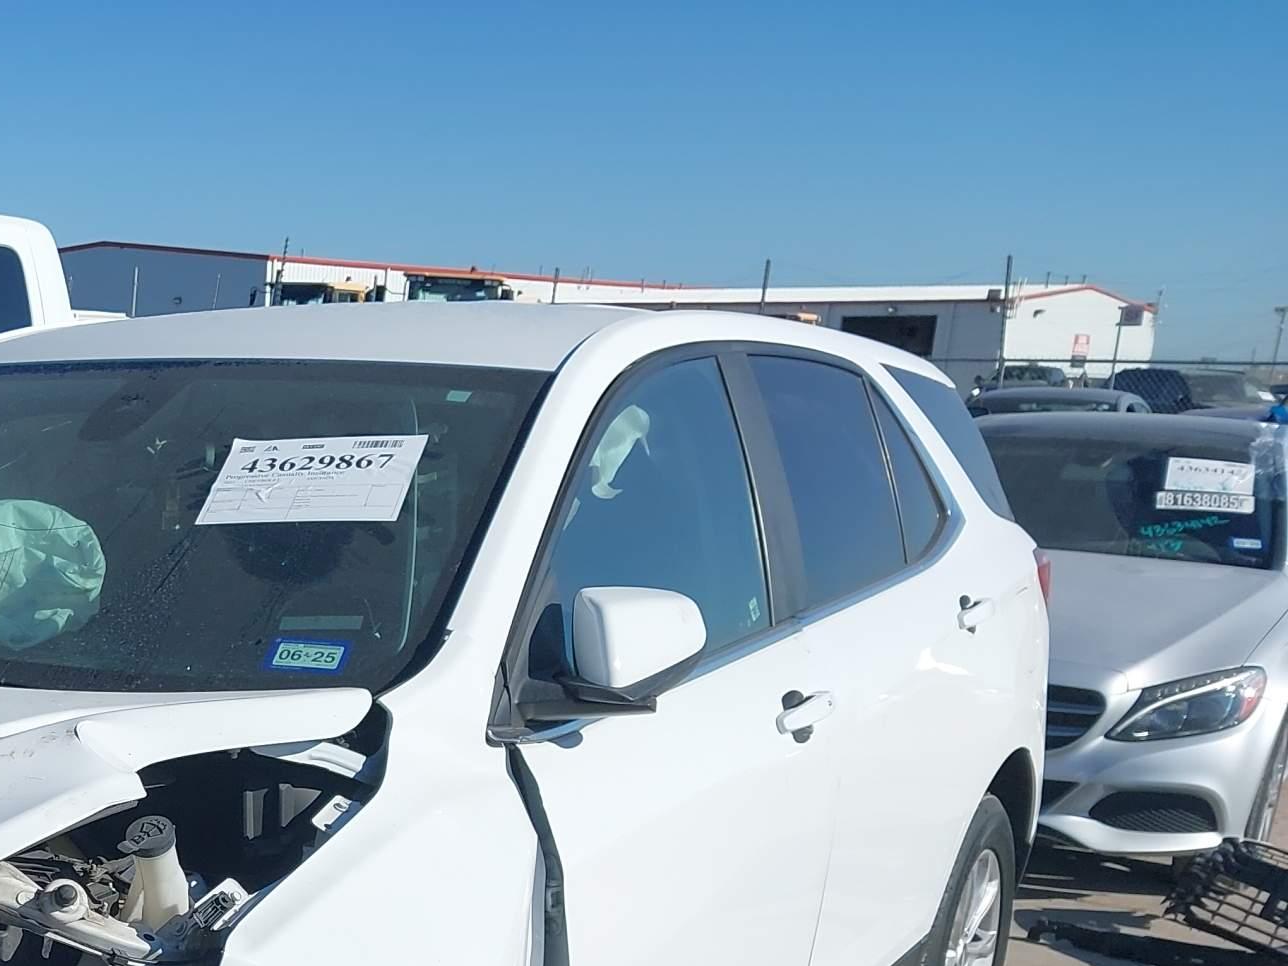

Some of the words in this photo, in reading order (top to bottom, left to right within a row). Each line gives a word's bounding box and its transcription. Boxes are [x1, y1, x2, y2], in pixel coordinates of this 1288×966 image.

[241, 453, 395, 473] 43629867
[278, 648, 303, 661] 06
[311, 651, 337, 664] 25
